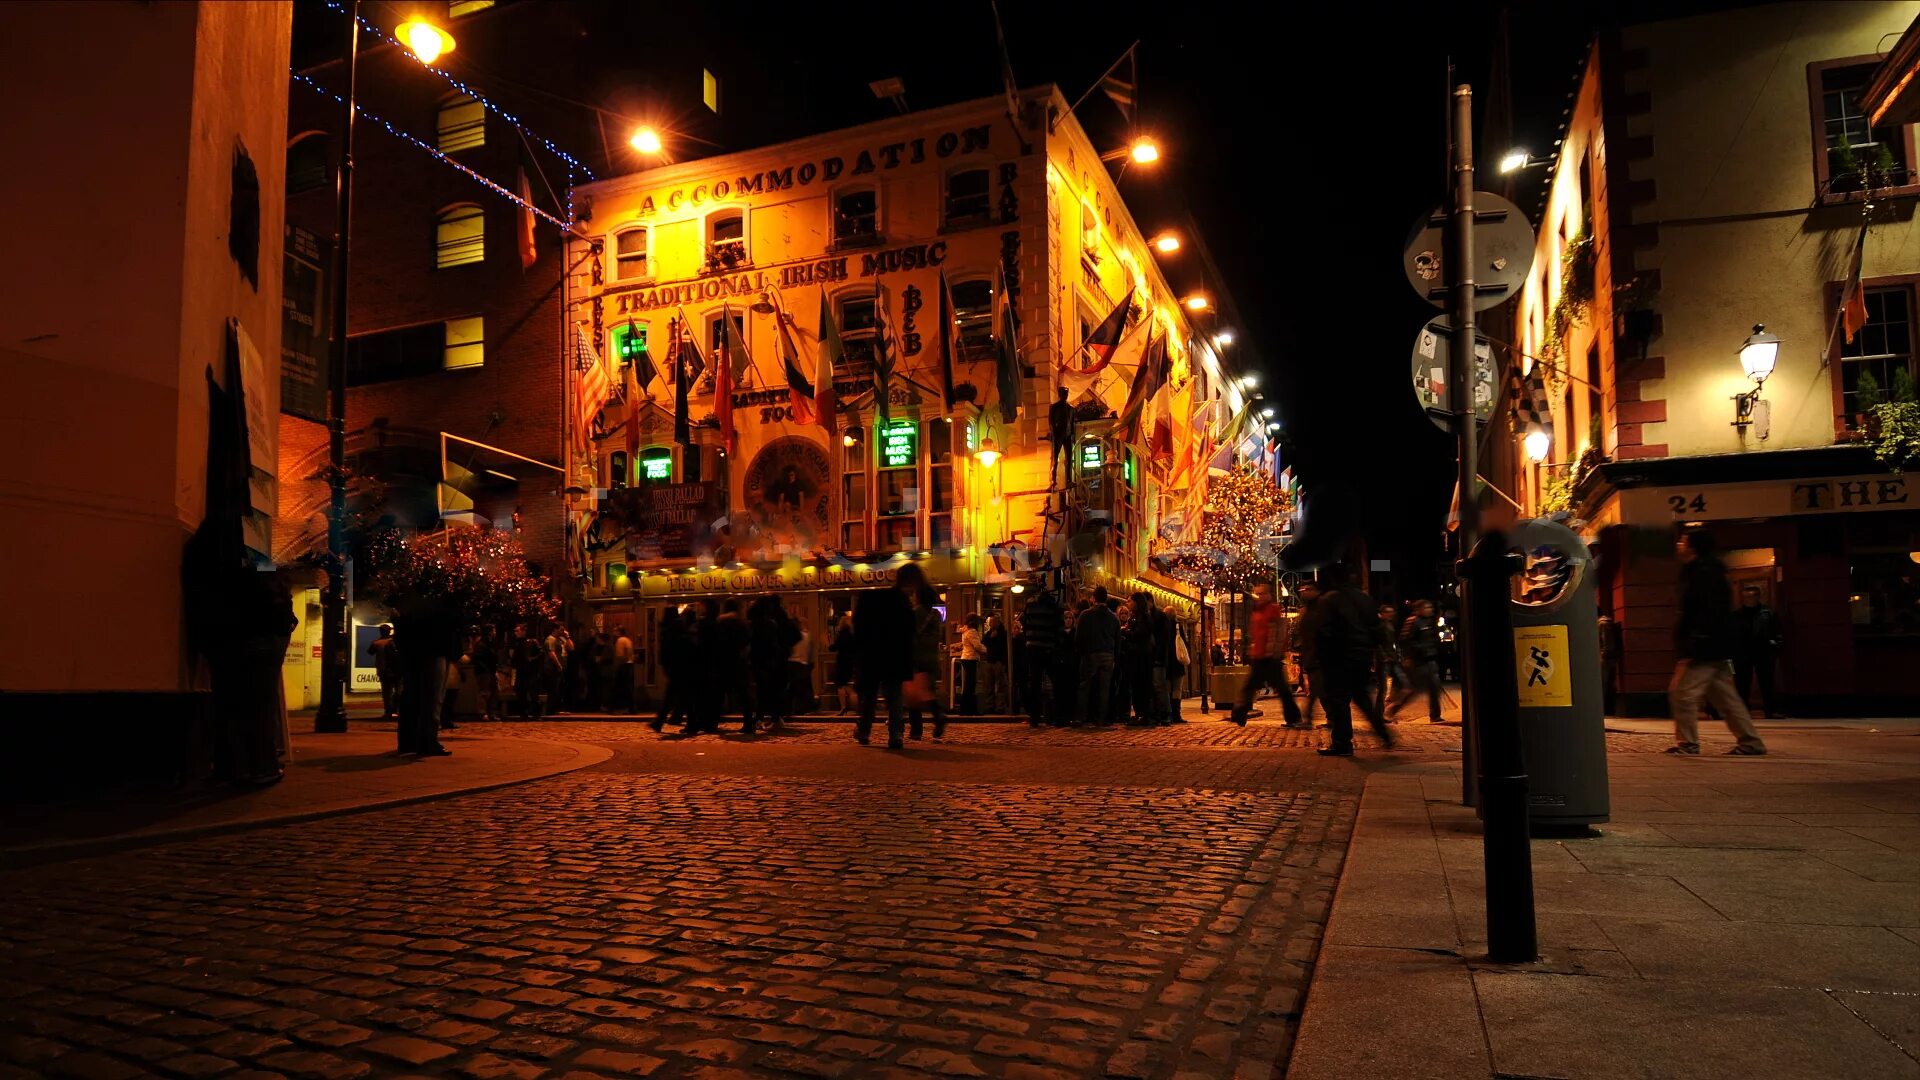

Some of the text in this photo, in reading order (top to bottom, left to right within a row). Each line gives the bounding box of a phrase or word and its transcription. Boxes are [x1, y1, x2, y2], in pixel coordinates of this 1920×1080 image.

[637, 124, 992, 218] ACCOMMODATION
[616, 241, 948, 315] TRADITIONAL IRISH MUSIC
[1668, 479, 1909, 513] 24 THE
[666, 575, 697, 592] THE
[731, 571, 788, 592] OLIVER
[814, 567, 854, 587] JOHN
